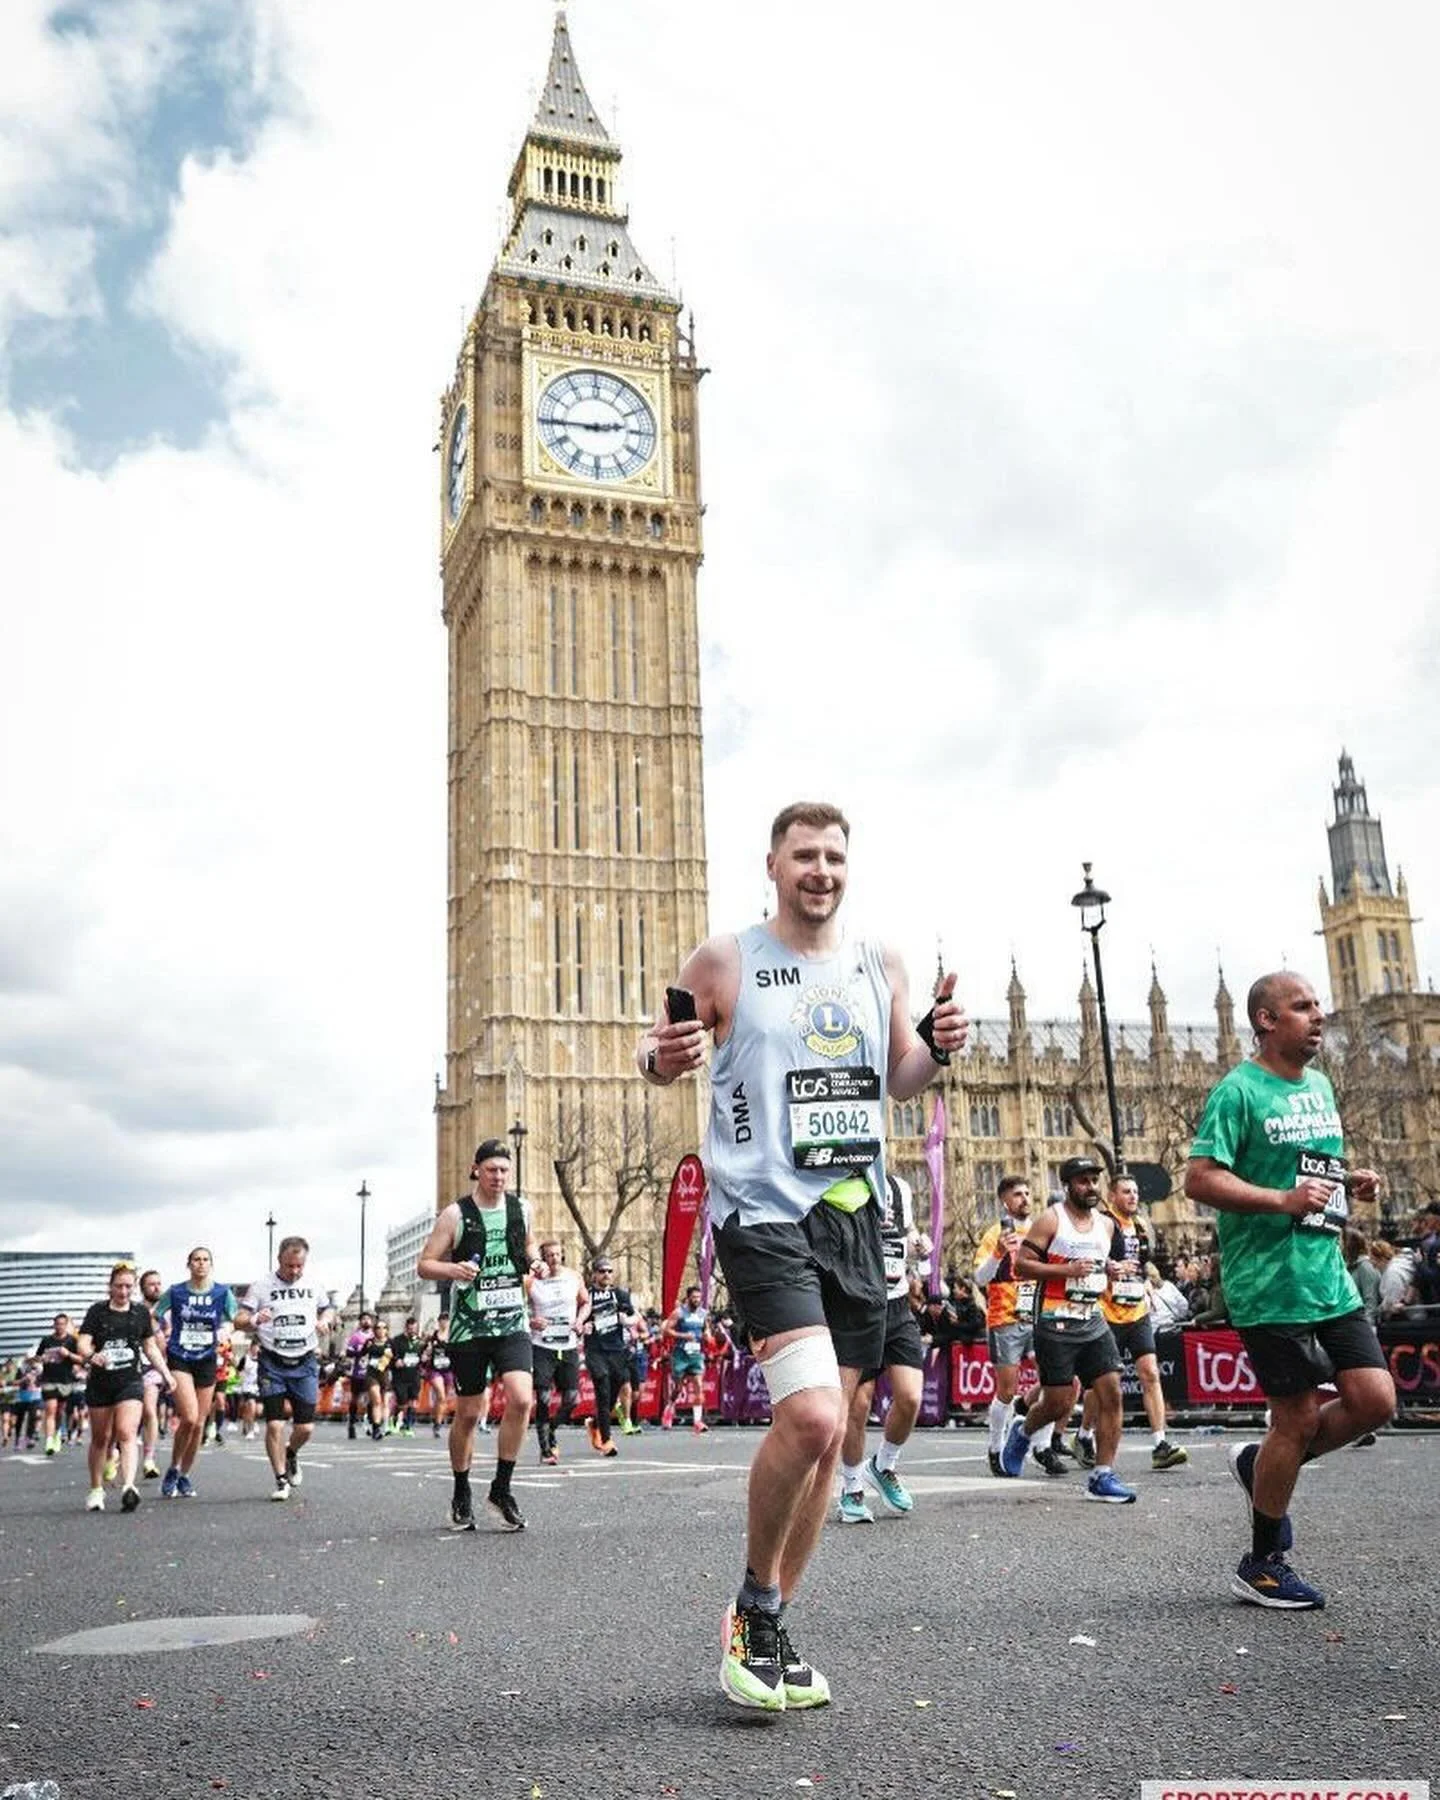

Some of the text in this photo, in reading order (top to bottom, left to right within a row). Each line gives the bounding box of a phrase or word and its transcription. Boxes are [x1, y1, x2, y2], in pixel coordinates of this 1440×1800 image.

[756, 967, 801, 988] SIM
[821, 1006, 845, 1032] L
[791, 1076, 829, 1098] tcs
[732, 1081, 752, 1144] DMA
[1287, 1092, 1325, 1113] STU
[809, 1110, 870, 1136] 50842
[1301, 1153, 1326, 1175] tcs
[959, 1353, 995, 1395] tcs
[1197, 1342, 1257, 1392] tcs
[1381, 1343, 1440, 1391] cs
